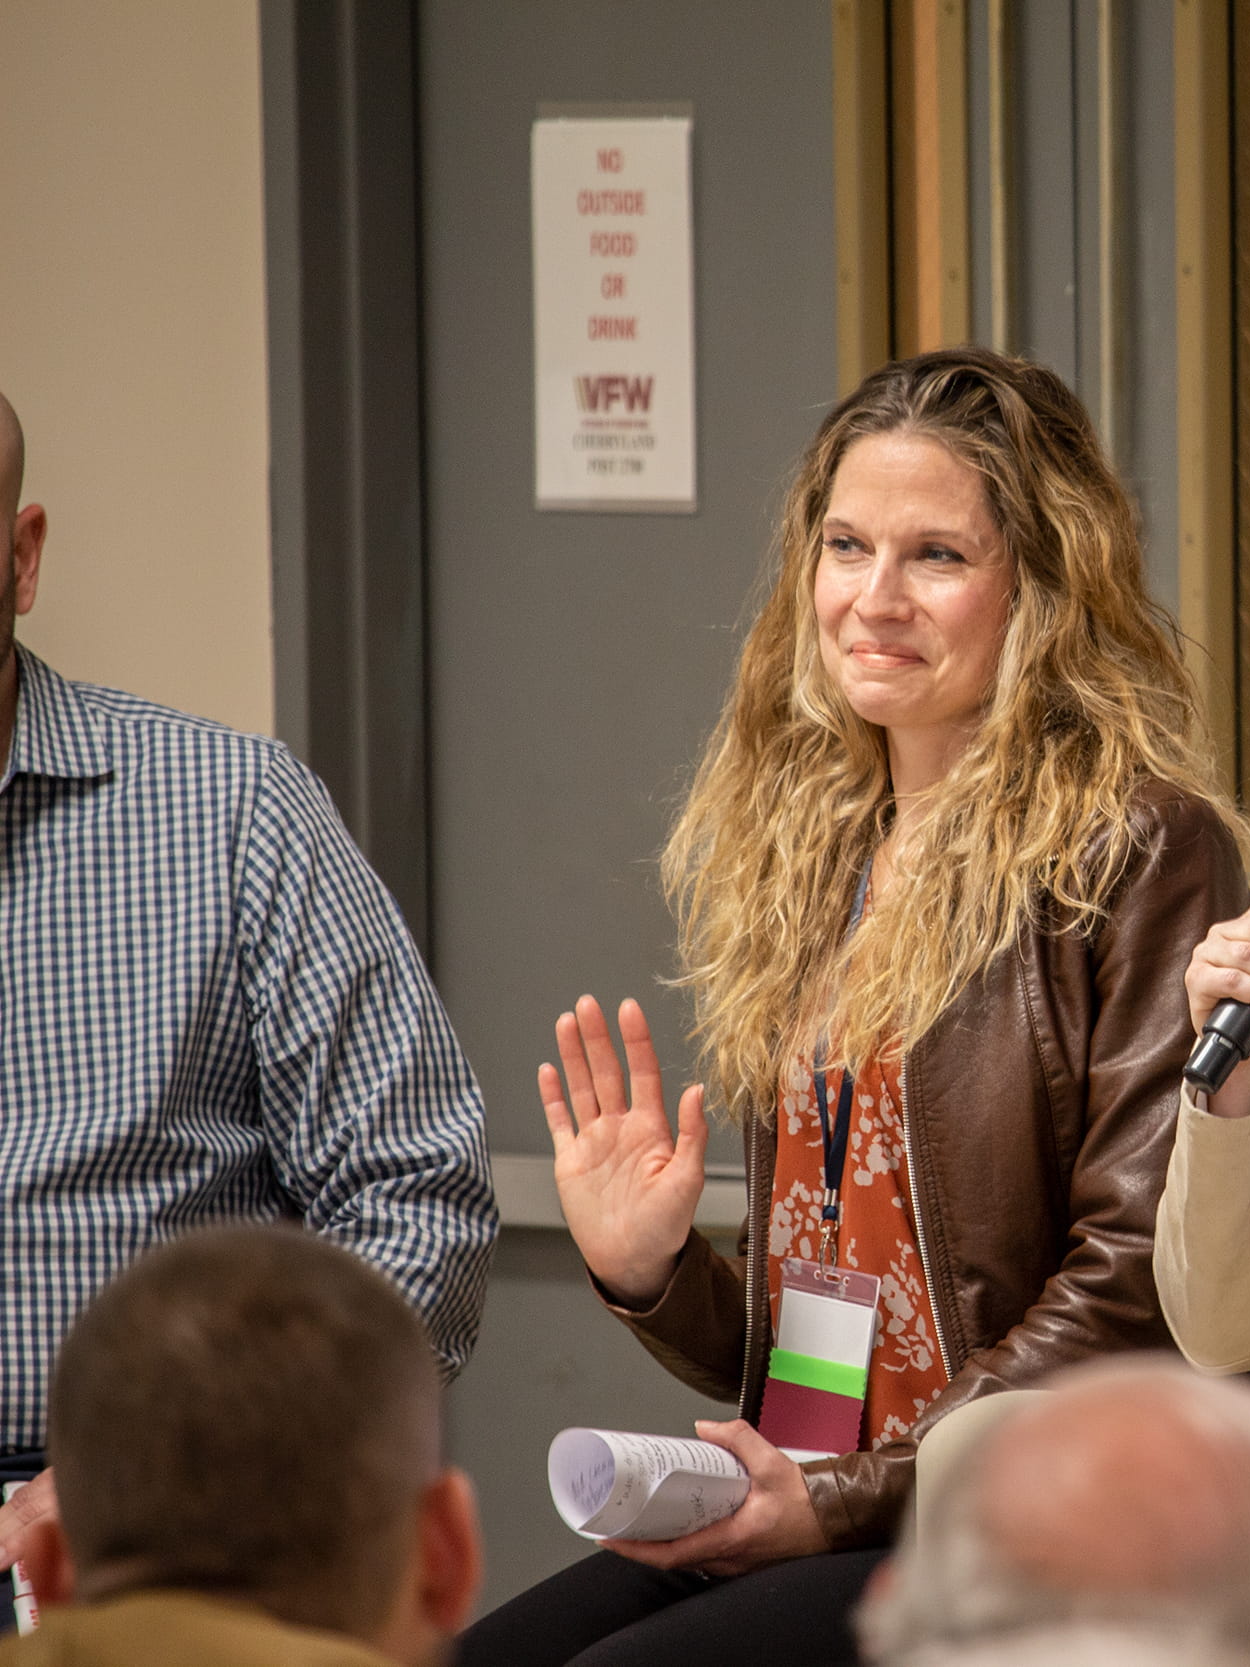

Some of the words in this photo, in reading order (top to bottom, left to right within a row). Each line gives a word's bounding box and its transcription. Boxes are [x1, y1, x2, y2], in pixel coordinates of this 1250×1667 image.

[597, 147, 623, 173] NO
[577, 189, 645, 216] OUTSIDE
[589, 231, 637, 257] FOOD
[602, 272, 626, 299] OR
[587, 315, 637, 341] DRINK
[578, 374, 654, 412] VFW
